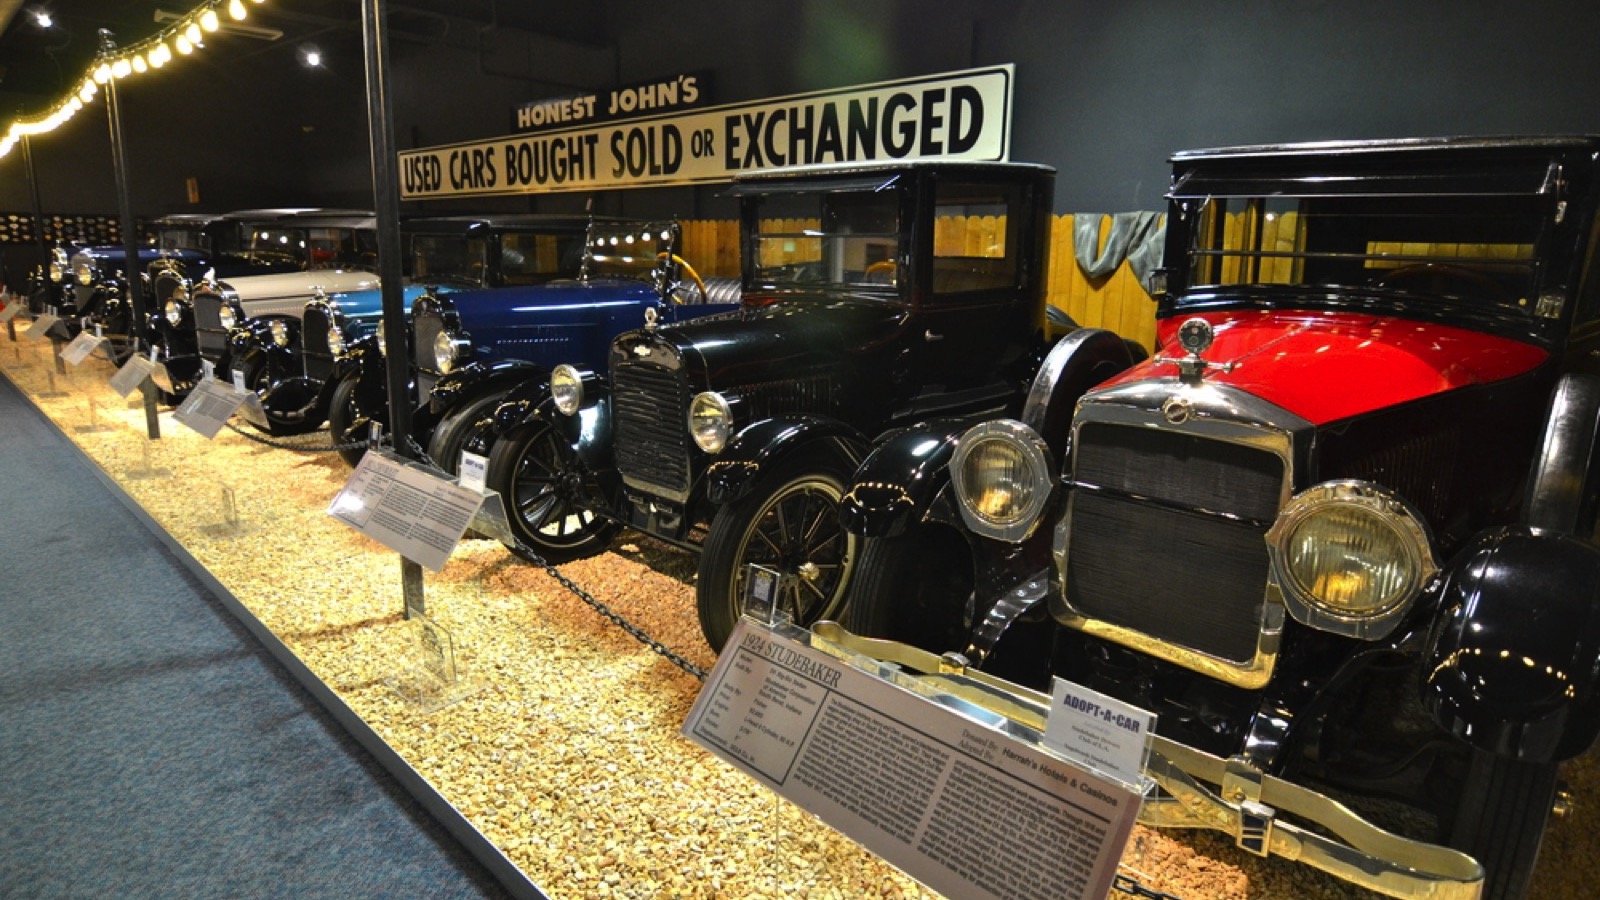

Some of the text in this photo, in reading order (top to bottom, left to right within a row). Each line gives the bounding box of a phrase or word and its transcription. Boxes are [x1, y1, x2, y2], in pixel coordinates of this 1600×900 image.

[517, 75, 699, 128] HONEST JOHN'S
[404, 85, 984, 193] USED CARS BOUGHT SOLD OR EXCHANGED
[742, 633, 766, 653] 1924
[765, 641, 842, 689] STUDEBAKER
[1002, 747, 1038, 770] Harrah's
[1039, 763, 1068, 784] Hotels
[1070, 778, 1078, 788] &
[1080, 782, 1119, 807] Casinos
